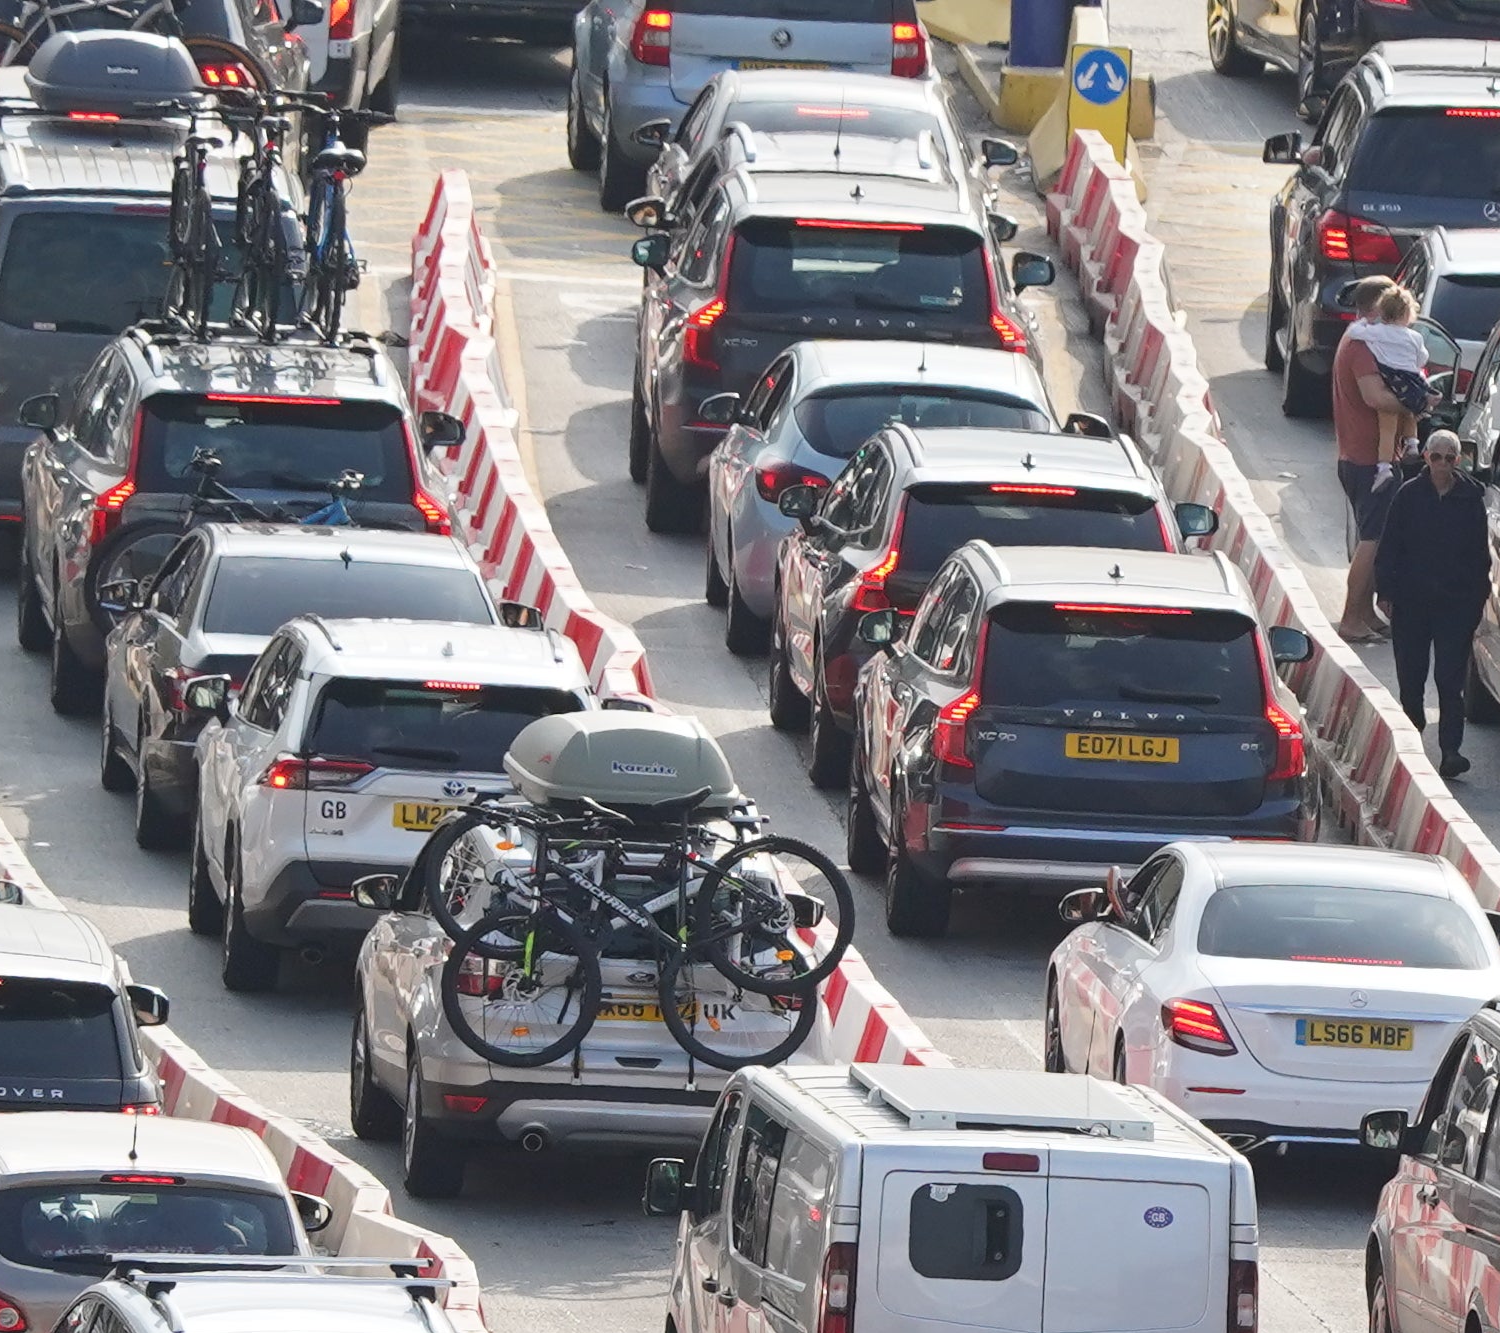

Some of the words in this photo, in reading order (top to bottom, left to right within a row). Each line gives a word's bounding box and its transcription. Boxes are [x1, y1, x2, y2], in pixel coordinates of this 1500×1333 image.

[800, 315, 916, 328] VOLVO
[1065, 708, 1185, 722] VOLVO
[977, 731, 1018, 743] XC90
[1126, 737, 1168, 758] LGJ
[320, 801, 347, 820] GB
[569, 871, 648, 928] ROCKRIDER
[702, 1004, 734, 1020] UK
[1309, 1024, 1363, 1043] LS66
[1369, 1027, 1409, 1047] MBF
[1151, 1212, 1165, 1223] GB
